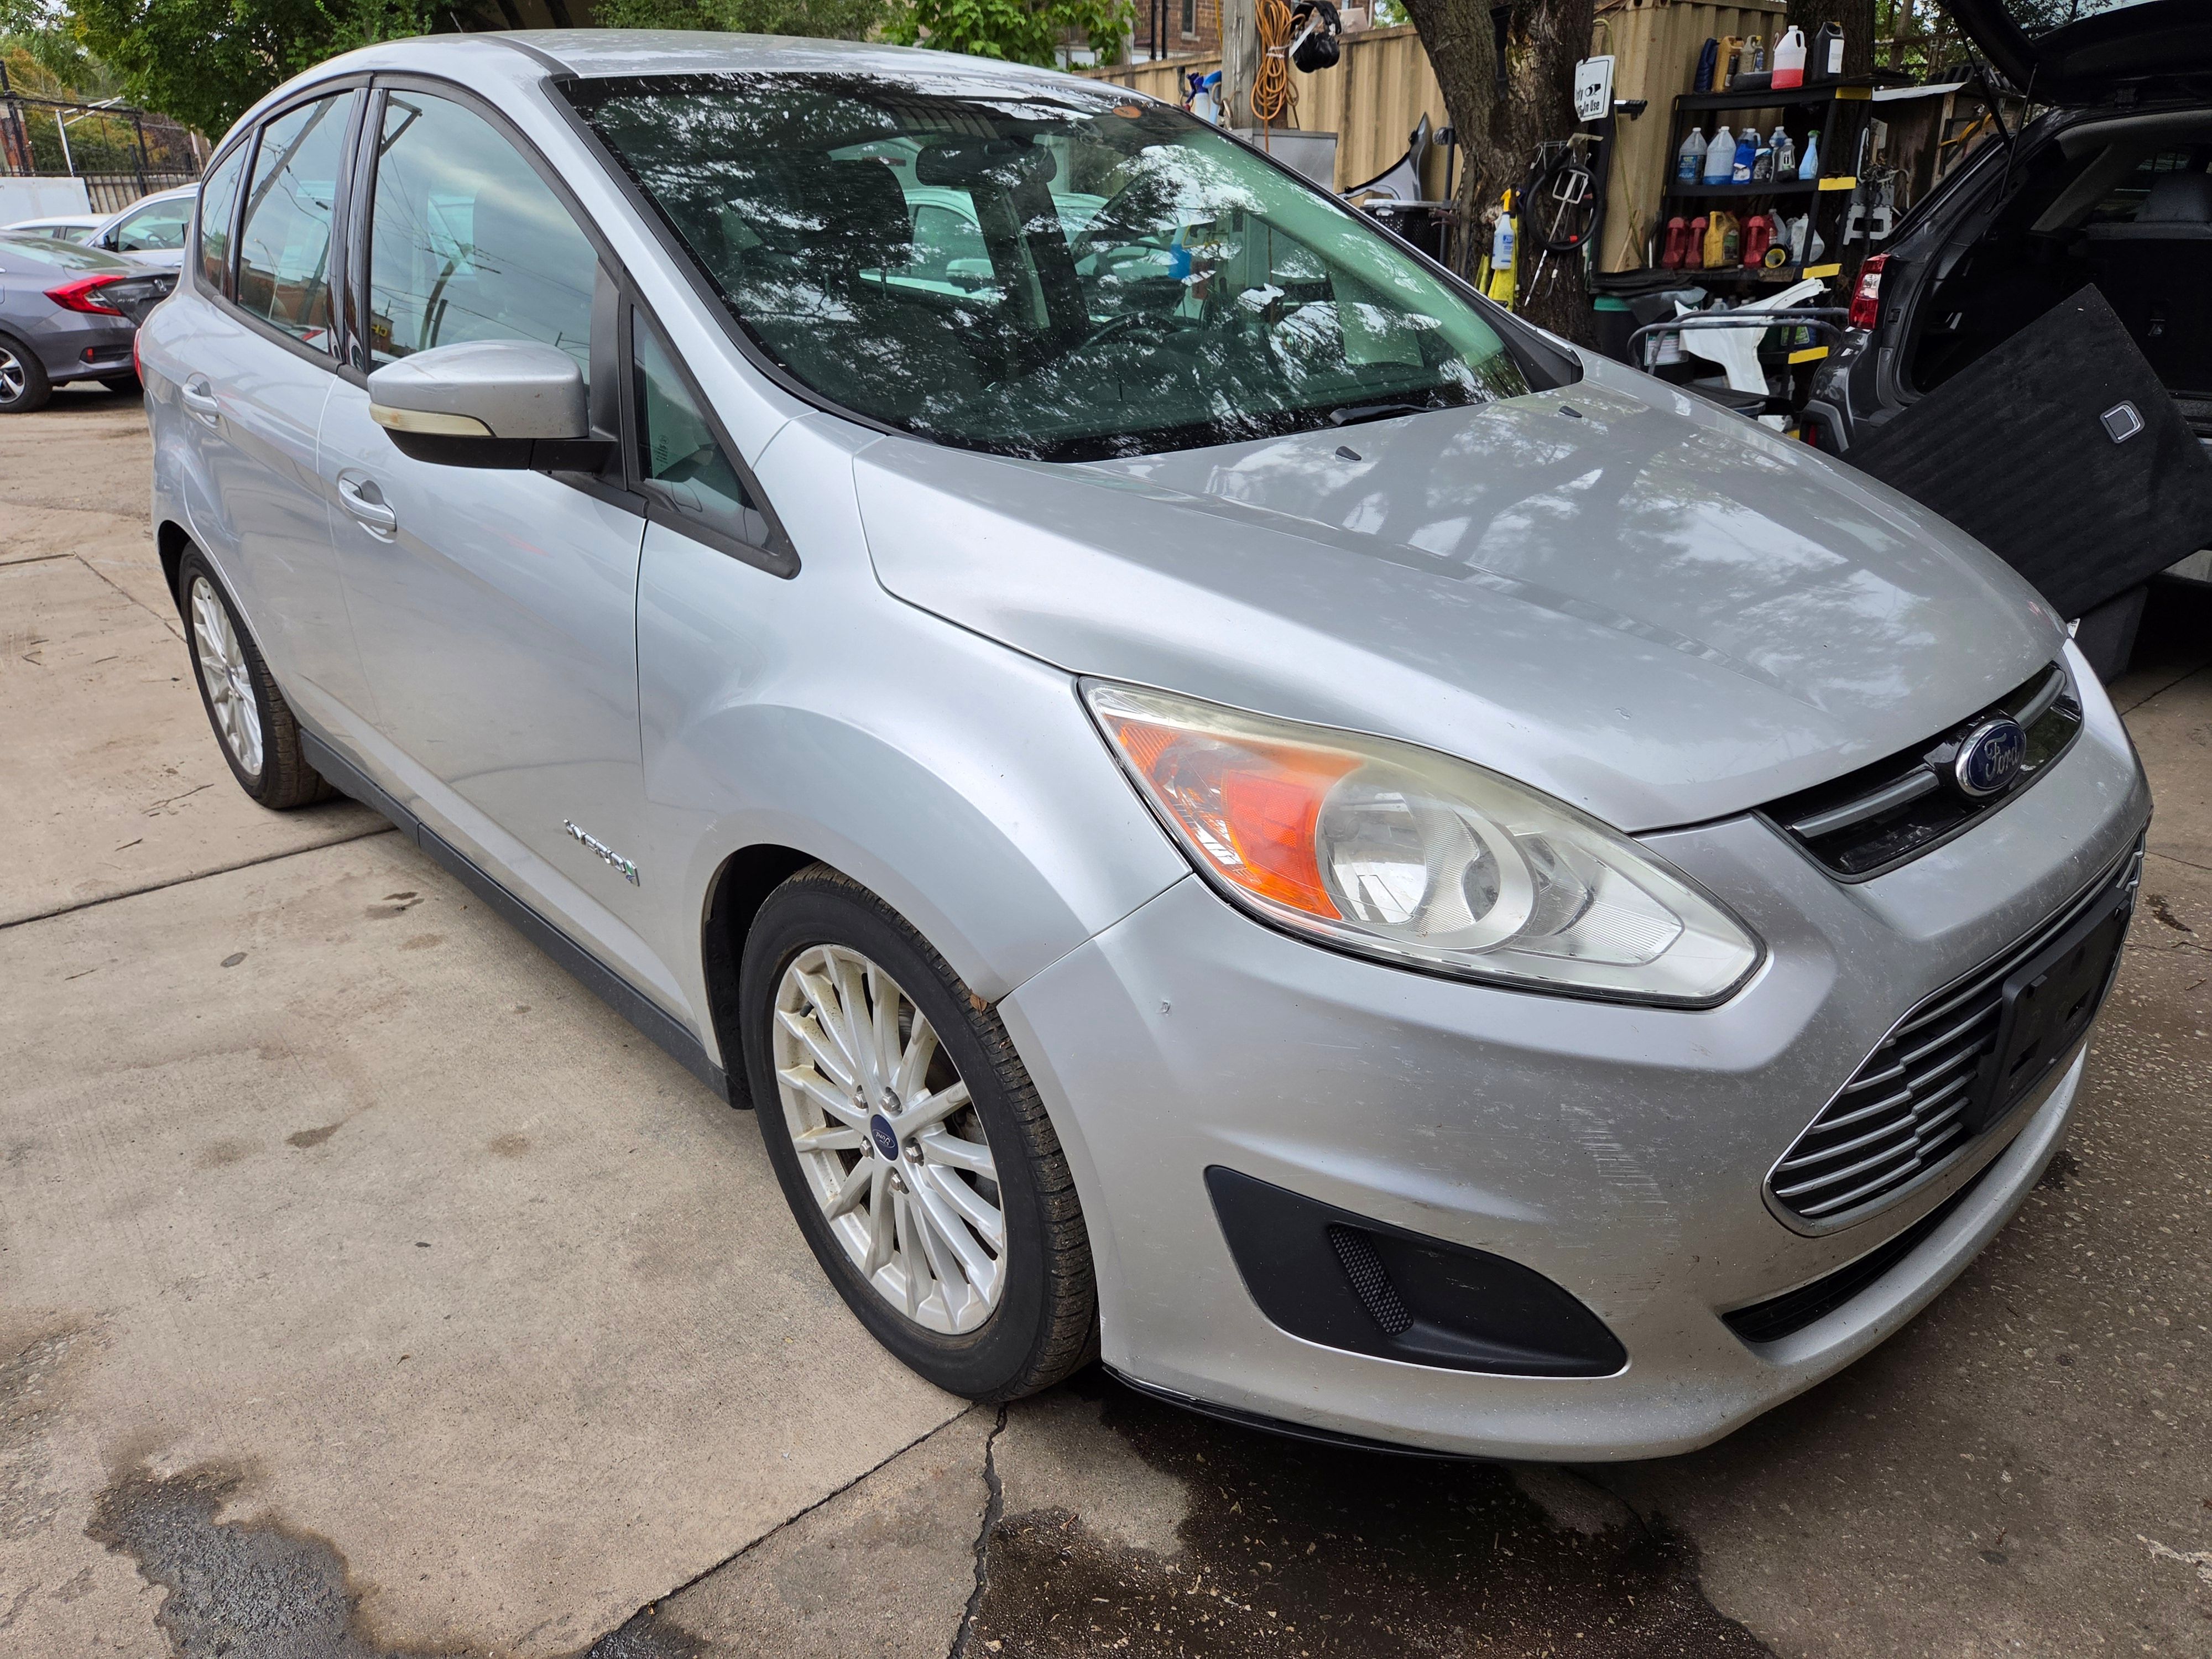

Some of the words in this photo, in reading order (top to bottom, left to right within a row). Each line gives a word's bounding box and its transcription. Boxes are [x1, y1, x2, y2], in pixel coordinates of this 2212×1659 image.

[1590, 100, 1600, 112] Use
[1984, 732, 2020, 781] Ford
[875, 1131, 891, 1146] Ford
